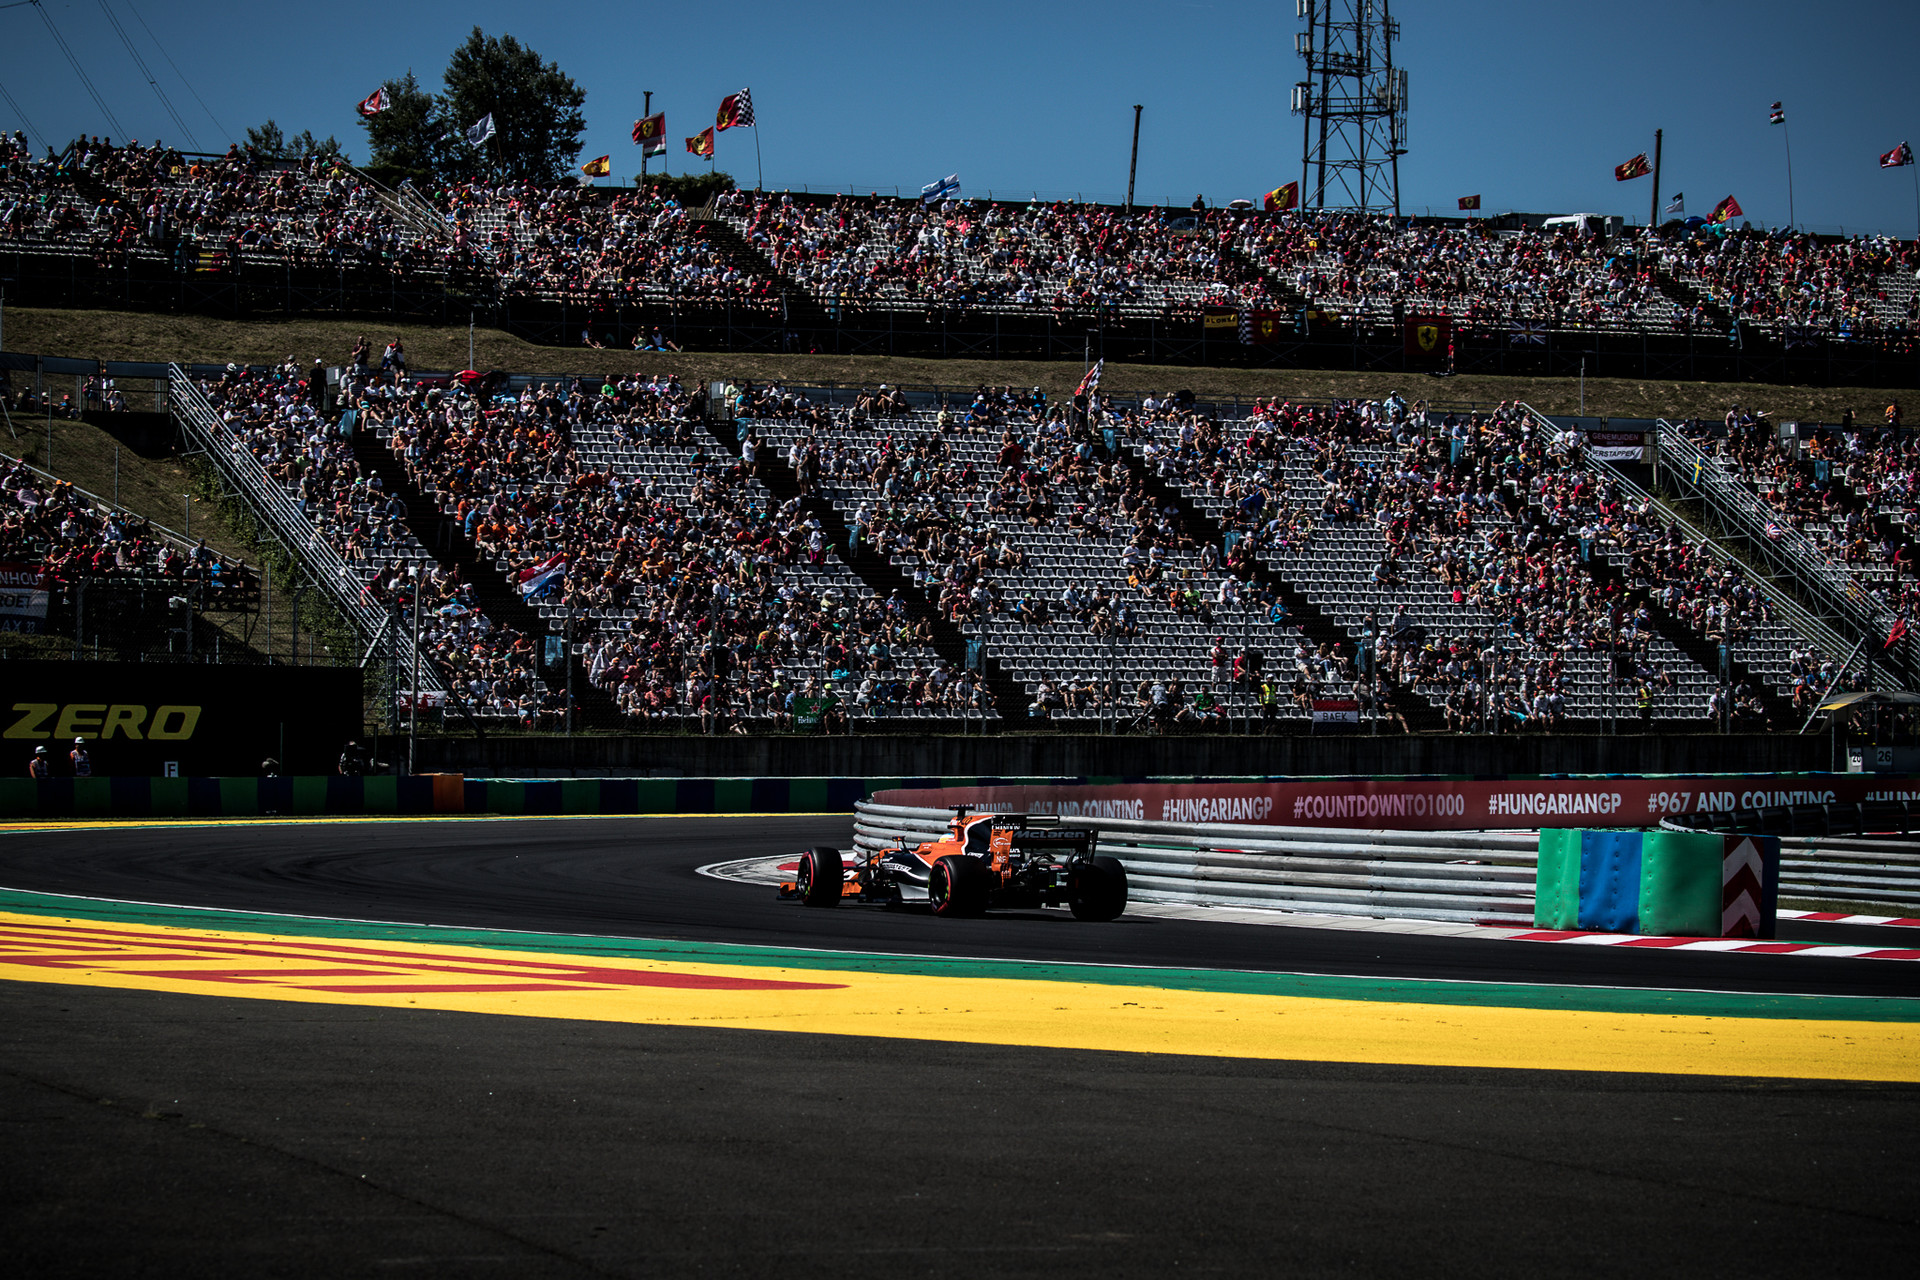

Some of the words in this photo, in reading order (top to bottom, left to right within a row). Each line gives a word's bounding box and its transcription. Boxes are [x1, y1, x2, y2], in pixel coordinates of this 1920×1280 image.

[3, 703, 202, 740] ZERO
[1322, 712, 1348, 721] BAEK
[1878, 751, 1892, 762] 26
[1082, 798, 1144, 820] COUNTING
[1162, 796, 1273, 822] #HUNGARIANGP
[1293, 793, 1465, 819] #COUNTDOWNTO1000
[1489, 792, 1622, 815] #HUNGARIANGP
[1648, 791, 1691, 813] #967
[1696, 791, 1736, 812] AND
[1741, 790, 1837, 809] COUNTING
[1012, 830, 1086, 839] McLaren
